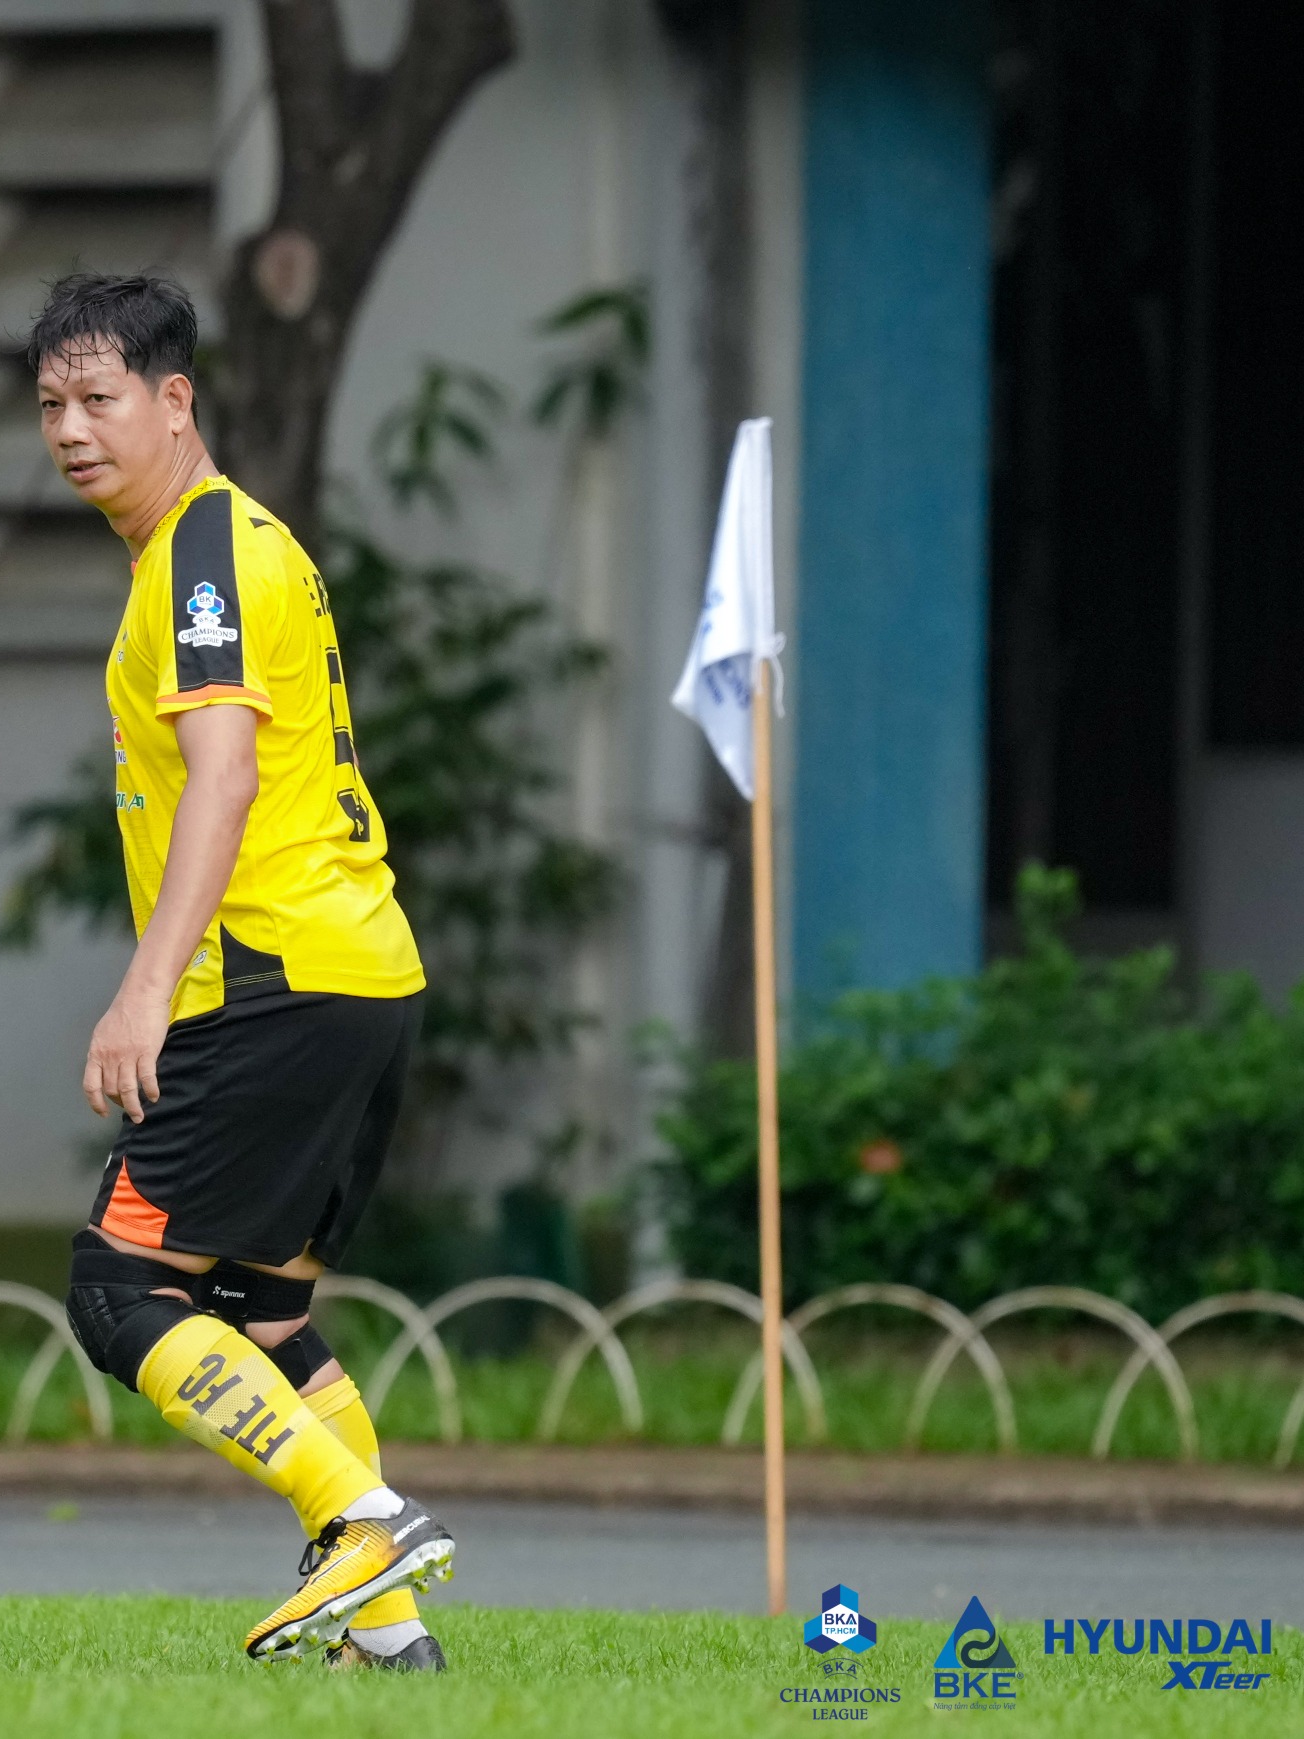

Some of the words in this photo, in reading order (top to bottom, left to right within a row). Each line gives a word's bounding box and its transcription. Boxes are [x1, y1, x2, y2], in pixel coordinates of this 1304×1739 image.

[181, 627, 235, 641] CHAMPIONS
[194, 636, 219, 644] LEAGUE
[177, 1353, 243, 1416] FC
[219, 1394, 295, 1466] FTE
